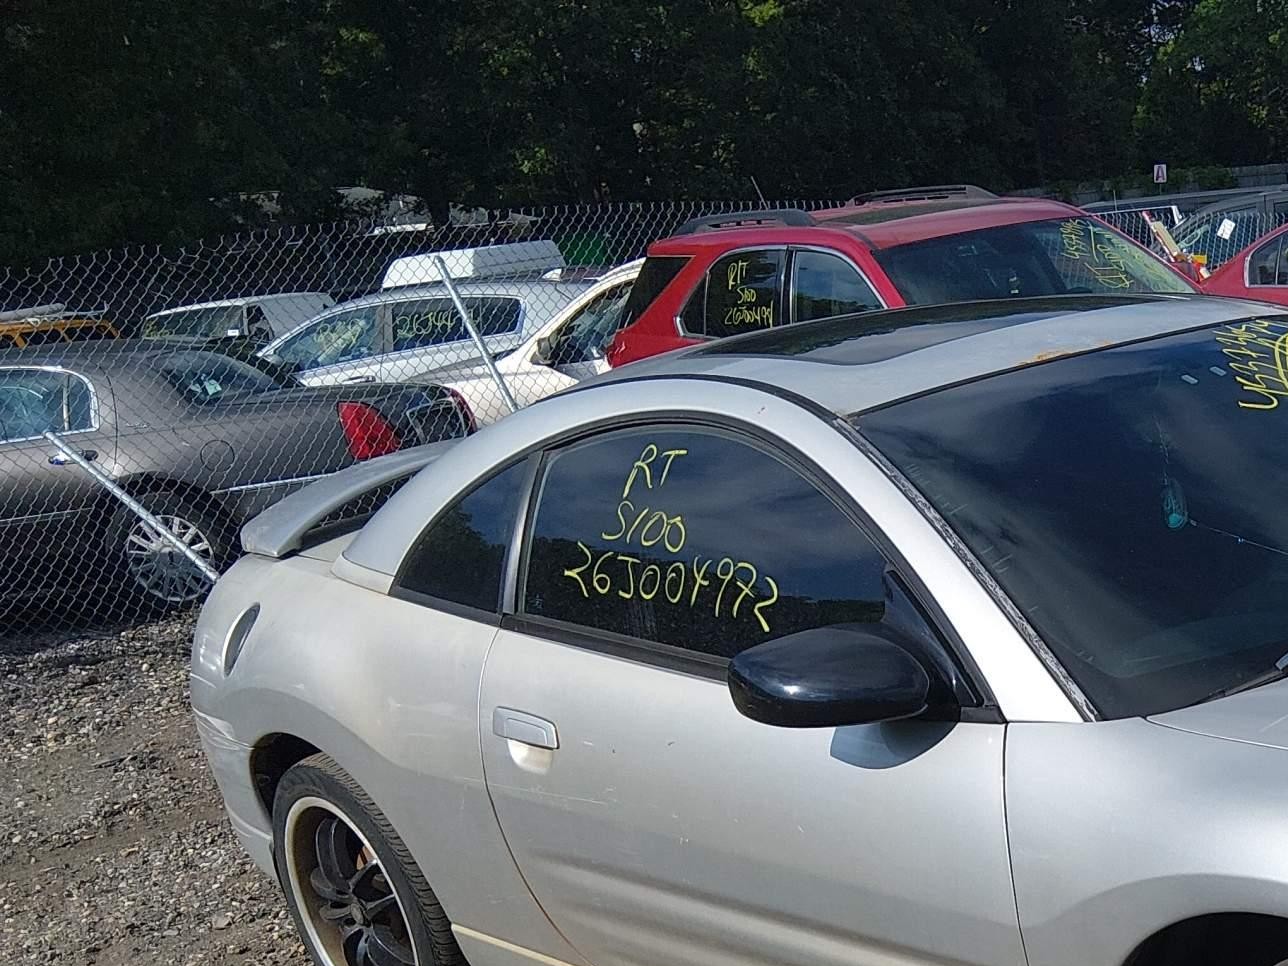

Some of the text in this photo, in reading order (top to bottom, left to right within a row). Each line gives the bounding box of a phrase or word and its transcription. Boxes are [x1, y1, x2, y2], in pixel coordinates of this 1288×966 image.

[1155, 166, 1165, 181] A
[623, 444, 688, 499] RT
[602, 500, 686, 552] S100
[563, 541, 778, 632] 26J004972
